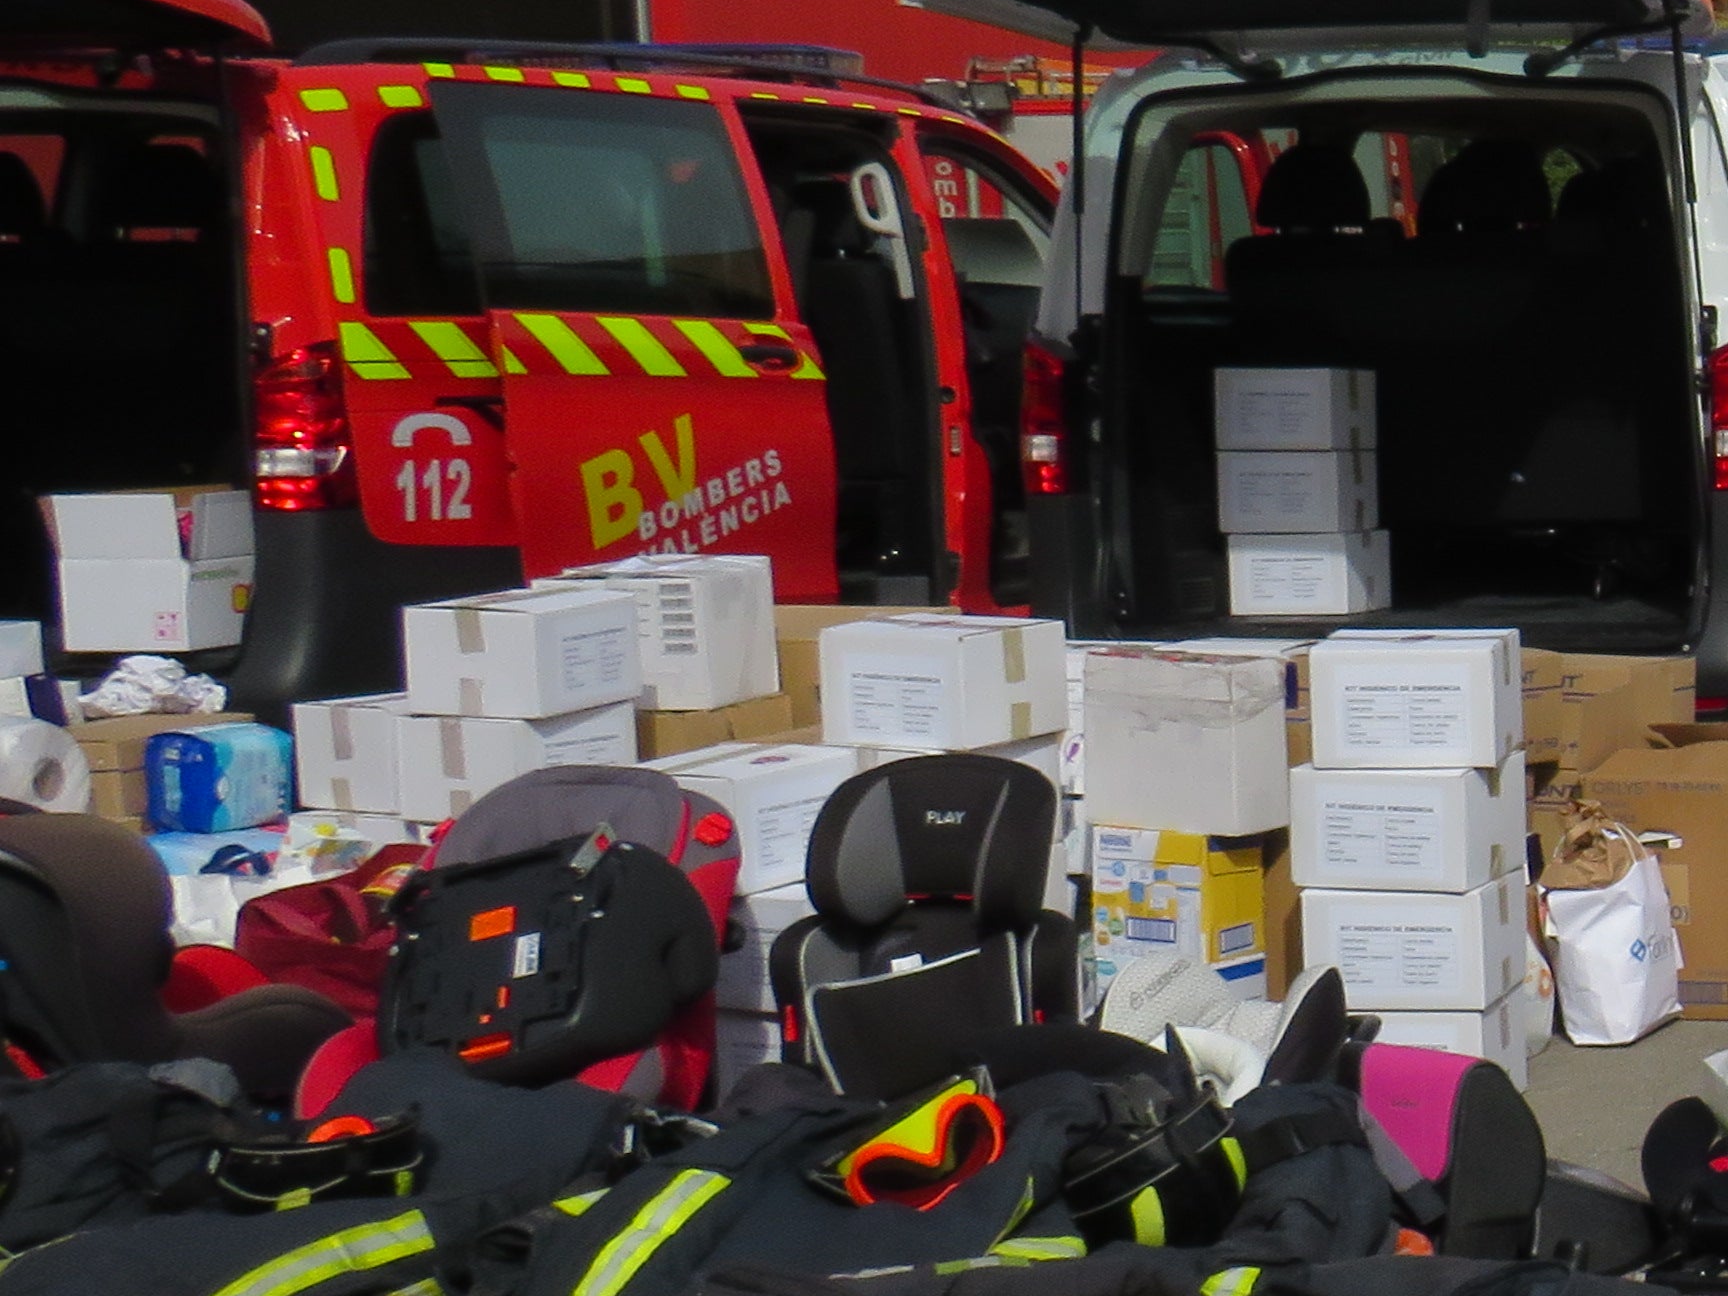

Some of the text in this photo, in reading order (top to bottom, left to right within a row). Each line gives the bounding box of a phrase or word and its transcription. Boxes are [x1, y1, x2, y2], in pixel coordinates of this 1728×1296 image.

[397, 458, 472, 522] 112
[579, 412, 697, 550] BV
[638, 448, 782, 541] BOMBERS
[926, 810, 967, 825] PLAY
